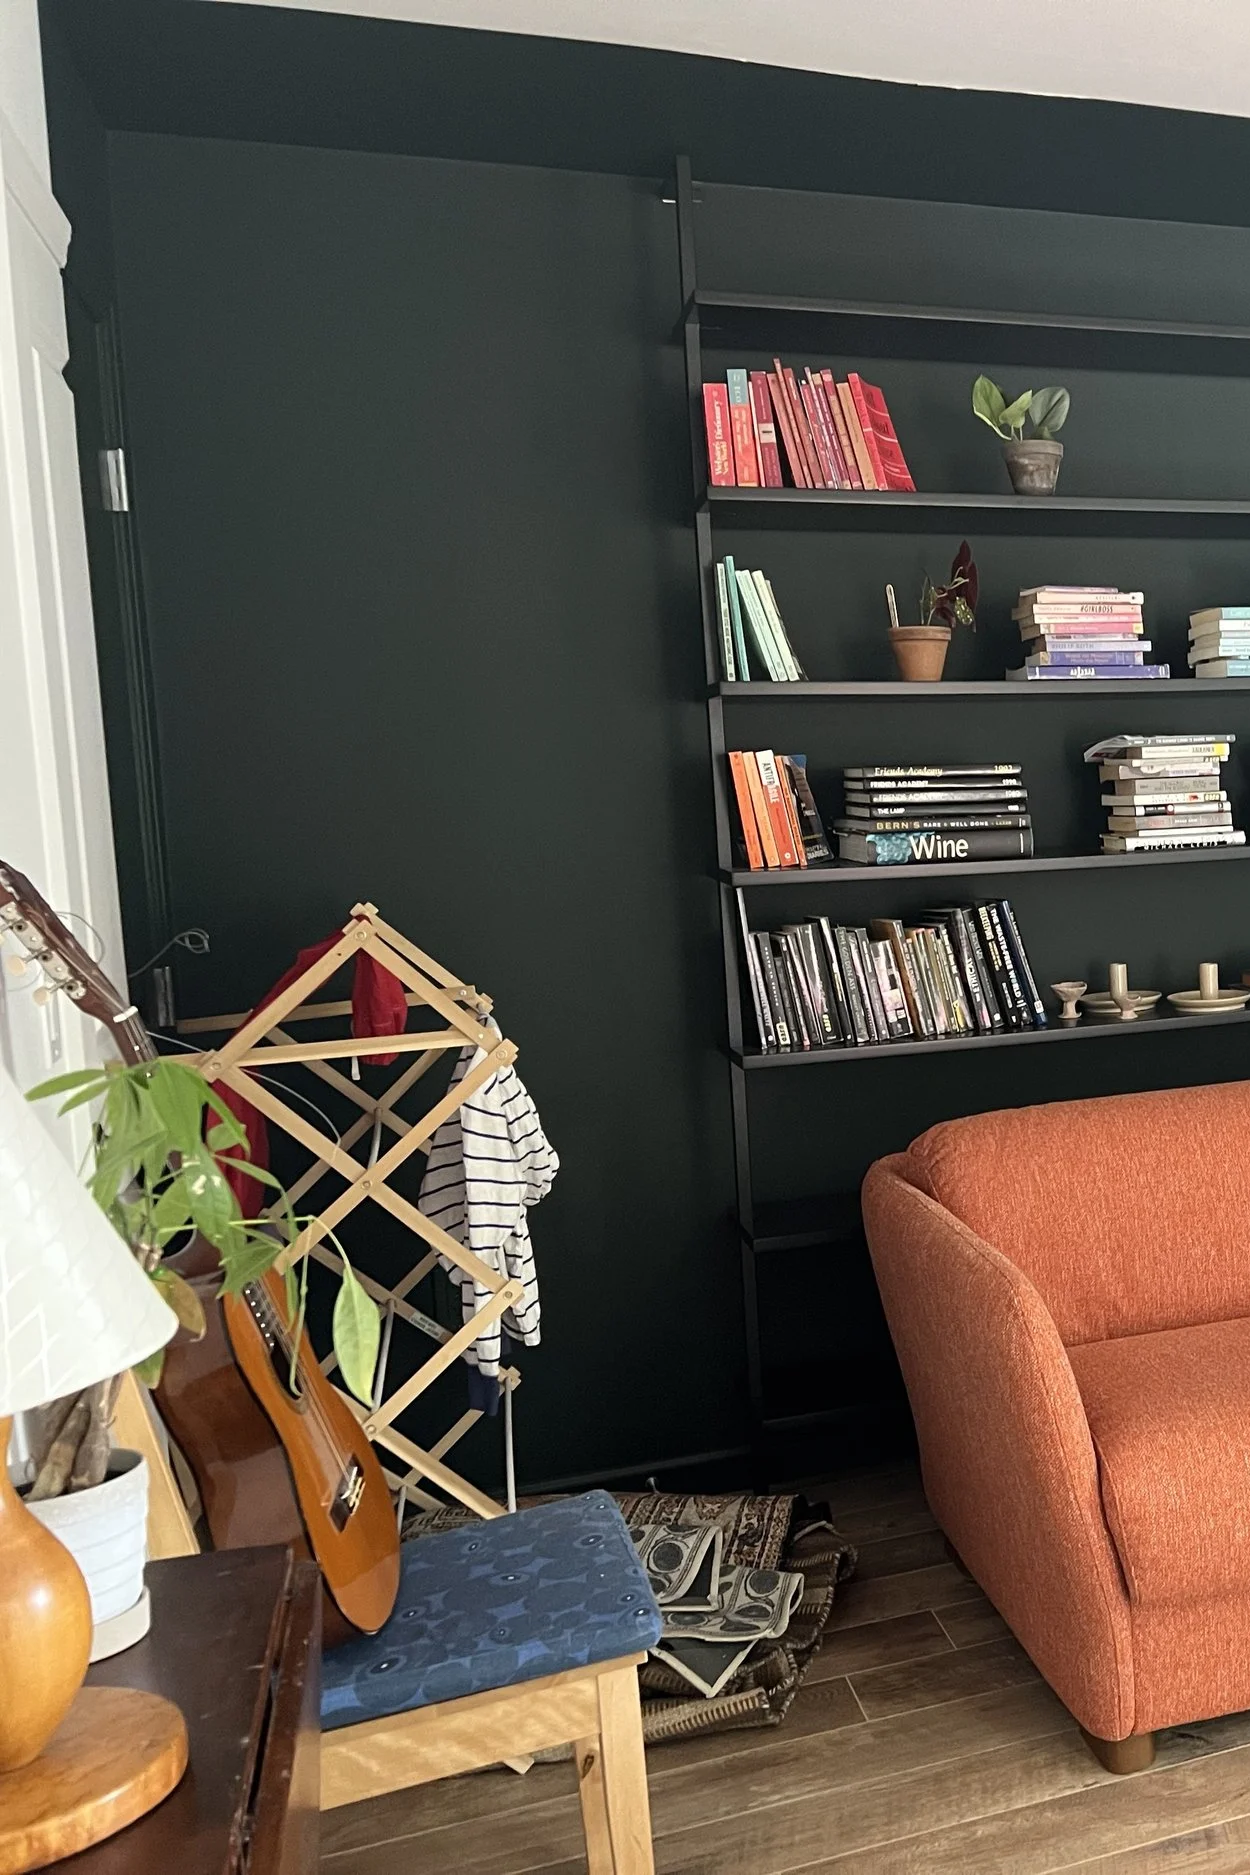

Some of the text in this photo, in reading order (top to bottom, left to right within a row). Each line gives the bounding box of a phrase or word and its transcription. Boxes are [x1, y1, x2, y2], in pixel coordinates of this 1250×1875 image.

[714, 400, 723, 440] Dictionary
[713, 442, 722, 475] Webster's
[1080, 604, 1113, 613] #GIRLBOSS
[762, 762, 780, 804] ANTIFRAGILE
[876, 820, 920, 830] BERN'S
[909, 834, 969, 860] Wine
[840, 946, 853, 976] GOLDEN
[989, 907, 999, 924] THE
[994, 923, 1013, 970] WASTE-FREE
[1007, 969, 1021, 998] WORLD
